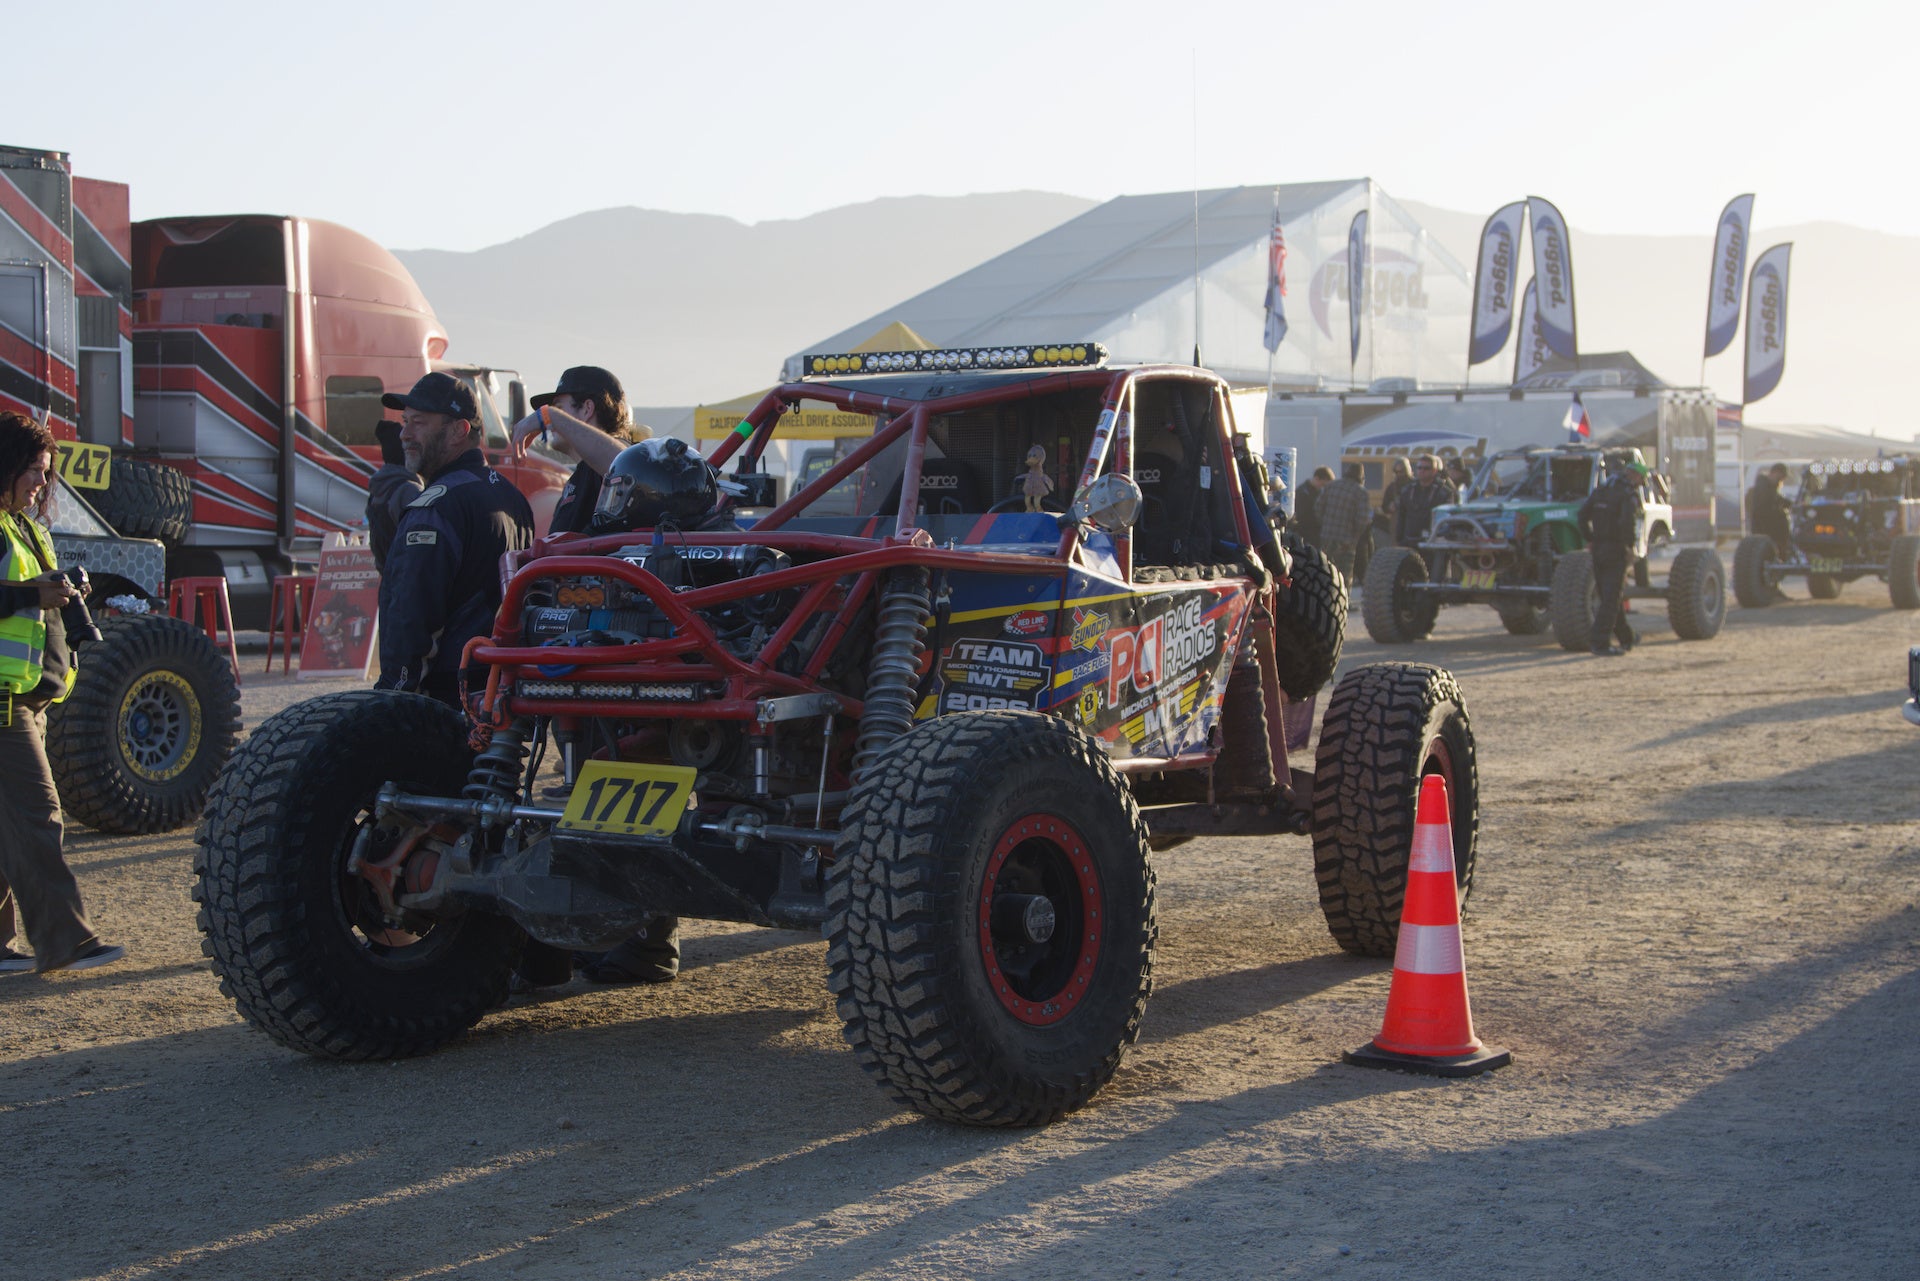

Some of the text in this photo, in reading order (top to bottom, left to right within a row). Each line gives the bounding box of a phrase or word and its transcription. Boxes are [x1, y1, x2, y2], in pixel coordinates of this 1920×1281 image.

[806, 414, 829, 427] DRIVE
[330, 581, 366, 591] INSIDE
[540, 613, 569, 621] PRO
[1165, 595, 1202, 646] RACE
[1073, 621, 1110, 644] SUNOCO
[959, 644, 1034, 667] TEAM
[1164, 619, 1217, 681] RADIOS
[946, 662, 1041, 678] MICKEY THOMPSON
[1072, 662, 1093, 680] RACE
[1108, 614, 1165, 710] PCI
[966, 671, 1020, 689] M/T
[1084, 693, 1095, 712] 8
[1121, 668, 1198, 720] MICKEY THOMPSON
[581, 777, 679, 825] 1717
